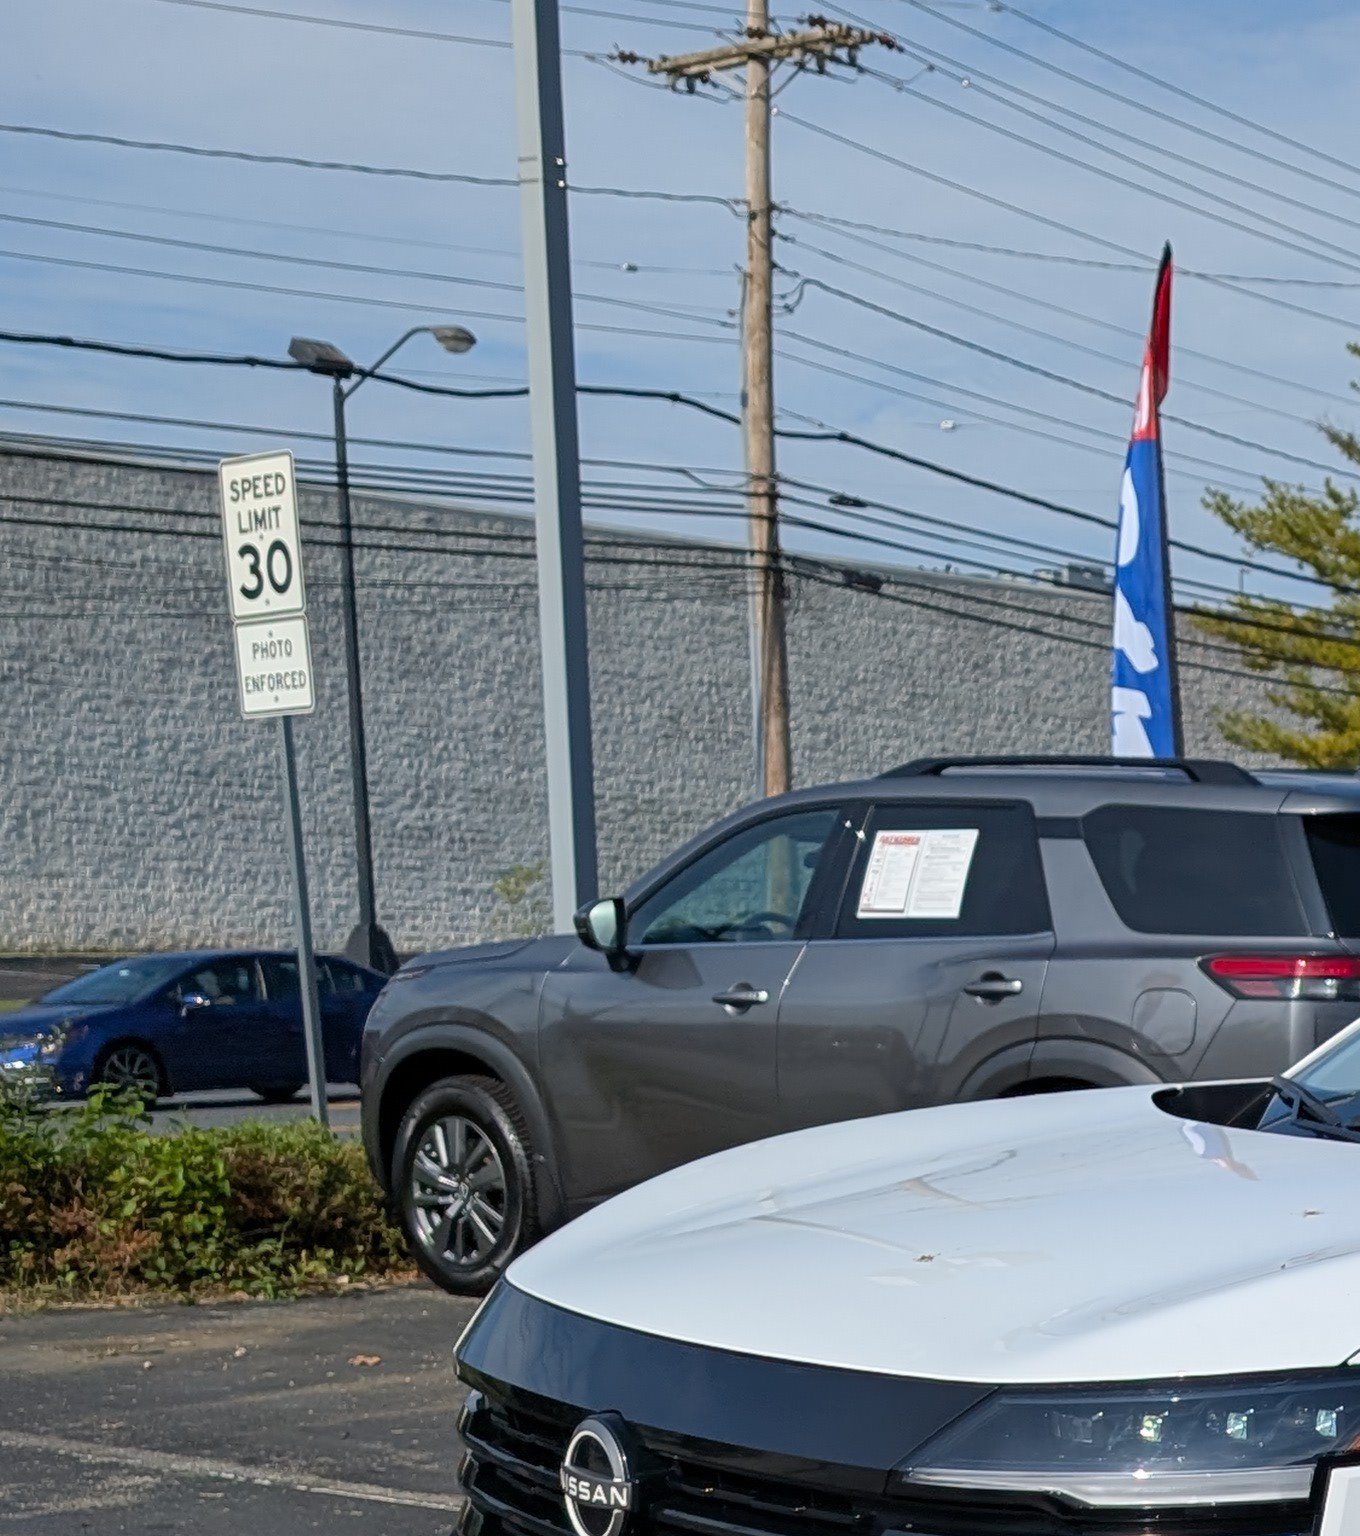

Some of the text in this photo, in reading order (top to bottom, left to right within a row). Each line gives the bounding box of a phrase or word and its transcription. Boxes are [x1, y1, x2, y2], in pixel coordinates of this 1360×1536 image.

[230, 472, 286, 502] SPEED
[238, 507, 282, 534] LIMIT
[238, 540, 293, 600] 30
[252, 640, 293, 661] PHOTO
[245, 669, 307, 694] ENFORCED
